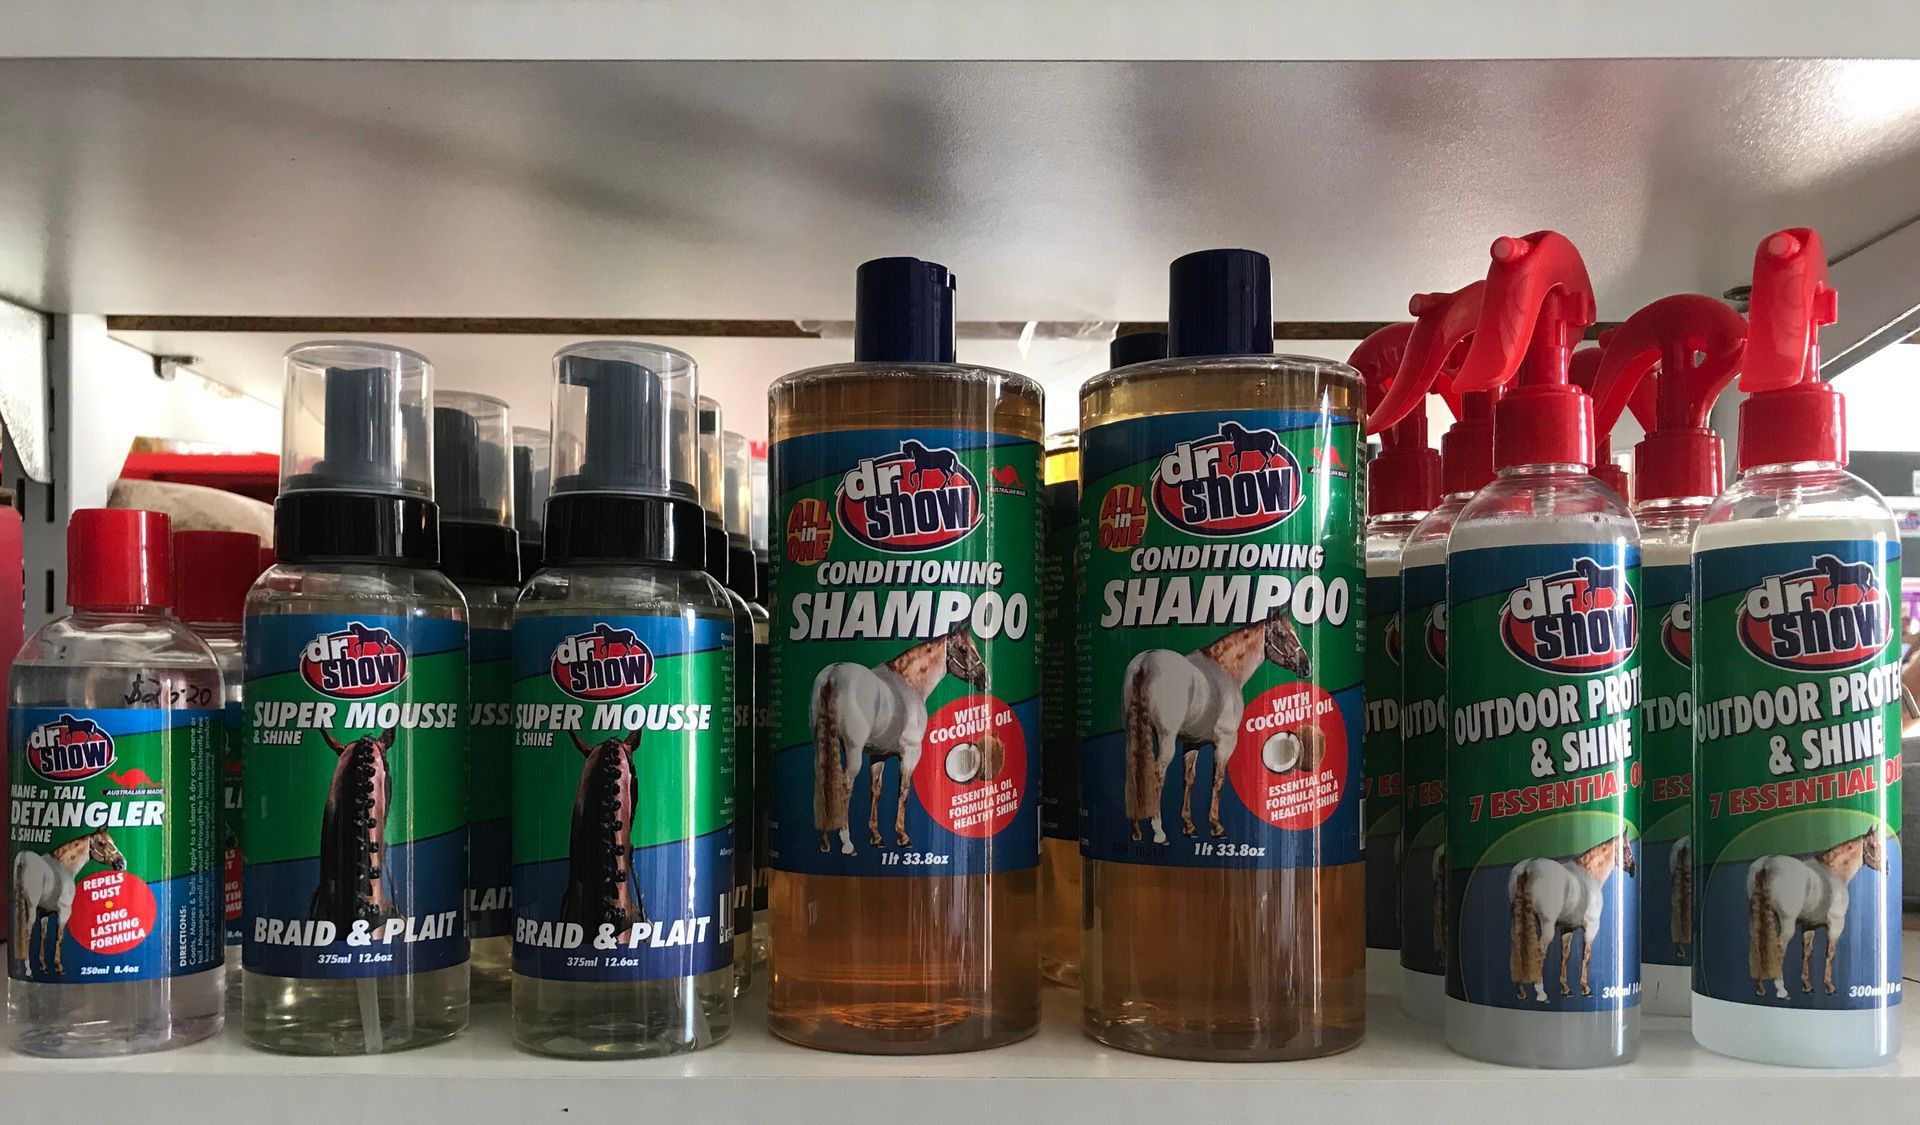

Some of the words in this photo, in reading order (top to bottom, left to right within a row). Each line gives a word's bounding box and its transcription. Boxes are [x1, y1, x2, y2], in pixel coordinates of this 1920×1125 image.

[1158, 444, 1220, 485] dr
[844, 460, 901, 501] dr
[1101, 487, 1146, 520] ALL
[1181, 466, 1293, 525] show
[789, 500, 831, 533] ALL
[864, 485, 971, 540] show
[1115, 508, 1131, 528] in
[800, 521, 817, 542] in
[1099, 520, 1144, 548] ONE
[787, 533, 830, 562] ONE
[1131, 544, 1324, 572] CONDITIONING
[816, 560, 1002, 585] CONDITIONING
[1100, 575, 1348, 627] SHAMPOO
[1510, 579, 1576, 621] dr
[1745, 577, 1815, 620] dr
[790, 590, 1028, 640] SHAMPOO
[1533, 604, 1634, 662] show
[1770, 603, 1884, 660] show
[306, 635, 349, 662] dr
[556, 637, 594, 665] dr
[321, 653, 400, 690] show
[569, 654, 647, 692] show
[253, 701, 337, 729] SUPER
[344, 702, 458, 729] MOUSSE
[954, 703, 990, 725] WITH
[1246, 704, 1312, 732] COCONUT
[1316, 698, 1334, 715] OIL
[1272, 691, 1310, 713] WITH
[1455, 684, 1580, 746] OUTDOOR
[1698, 682, 1819, 744] OUTDOOR
[189, 717, 196, 726] or
[516, 704, 584, 731] SUPER
[591, 704, 712, 731] MOUSSE
[929, 717, 992, 744] COCONUT
[995, 709, 1012, 726] OIL
[31, 726, 60, 750] dr
[253, 731, 260, 744] &
[262, 731, 302, 745] SHINE
[515, 732, 520, 745] &
[522, 732, 553, 747] SHINE
[1531, 737, 1555, 777] &
[1562, 718, 1632, 773] SHINE
[1769, 735, 1795, 775] &
[1802, 716, 1885, 771] SHINE
[40, 740, 107, 772] show
[197, 772, 204, 780] to
[1269, 774, 1319, 797] ESSENTIAL
[1321, 769, 1333, 782] OIL
[11, 784, 36, 799] MANE
[40, 789, 48, 799] n
[53, 786, 86, 800] TAIL
[949, 797, 994, 819] FORMULA
[996, 791, 1011, 805] FOR
[1012, 788, 1018, 798] A
[952, 782, 998, 806] ESSENTIAL
[1000, 778, 1013, 790] OIL
[1266, 788, 1315, 810] FORMULA
[1316, 783, 1332, 797] FOR
[1333, 780, 1338, 790] A
[1470, 796, 1484, 822] 7
[1490, 771, 1627, 818] ESSENTIAL
[1710, 792, 1723, 819] 7
[1729, 766, 1877, 816] ESSENTIAL
[11, 801, 165, 827] DETANGLER
[953, 809, 994, 830] HEALTHY
[996, 800, 1018, 816] SHINE
[1271, 800, 1314, 822] HEALTHY
[1316, 792, 1338, 809] SHINE
[11, 829, 16, 840] &
[18, 829, 52, 843] SHINE
[189, 837, 196, 846] to
[1216, 843, 1265, 857] 33.8oz
[902, 852, 949, 865] 33.8oz
[83, 873, 124, 891] REPELS
[91, 886, 121, 901] DUST
[90, 918, 139, 938] LASTING
[96, 908, 128, 924] LONG
[254, 917, 337, 947] BRAID
[346, 919, 373, 947] &
[382, 911, 457, 945] PLAIT
[90, 928, 146, 950] FORMULA
[179, 905, 187, 967] DIRECTIONS:
[515, 917, 584, 949] BRAID
[593, 923, 619, 950] &
[628, 916, 711, 949] PLAIT
[80, 966, 109, 975] 250ml
[114, 965, 139, 974] 8.4oz
[317, 954, 352, 964] 375ml
[358, 953, 393, 964] 12.6oz
[566, 957, 598, 967] 375ml
[604, 956, 639, 967] 12.6oz
